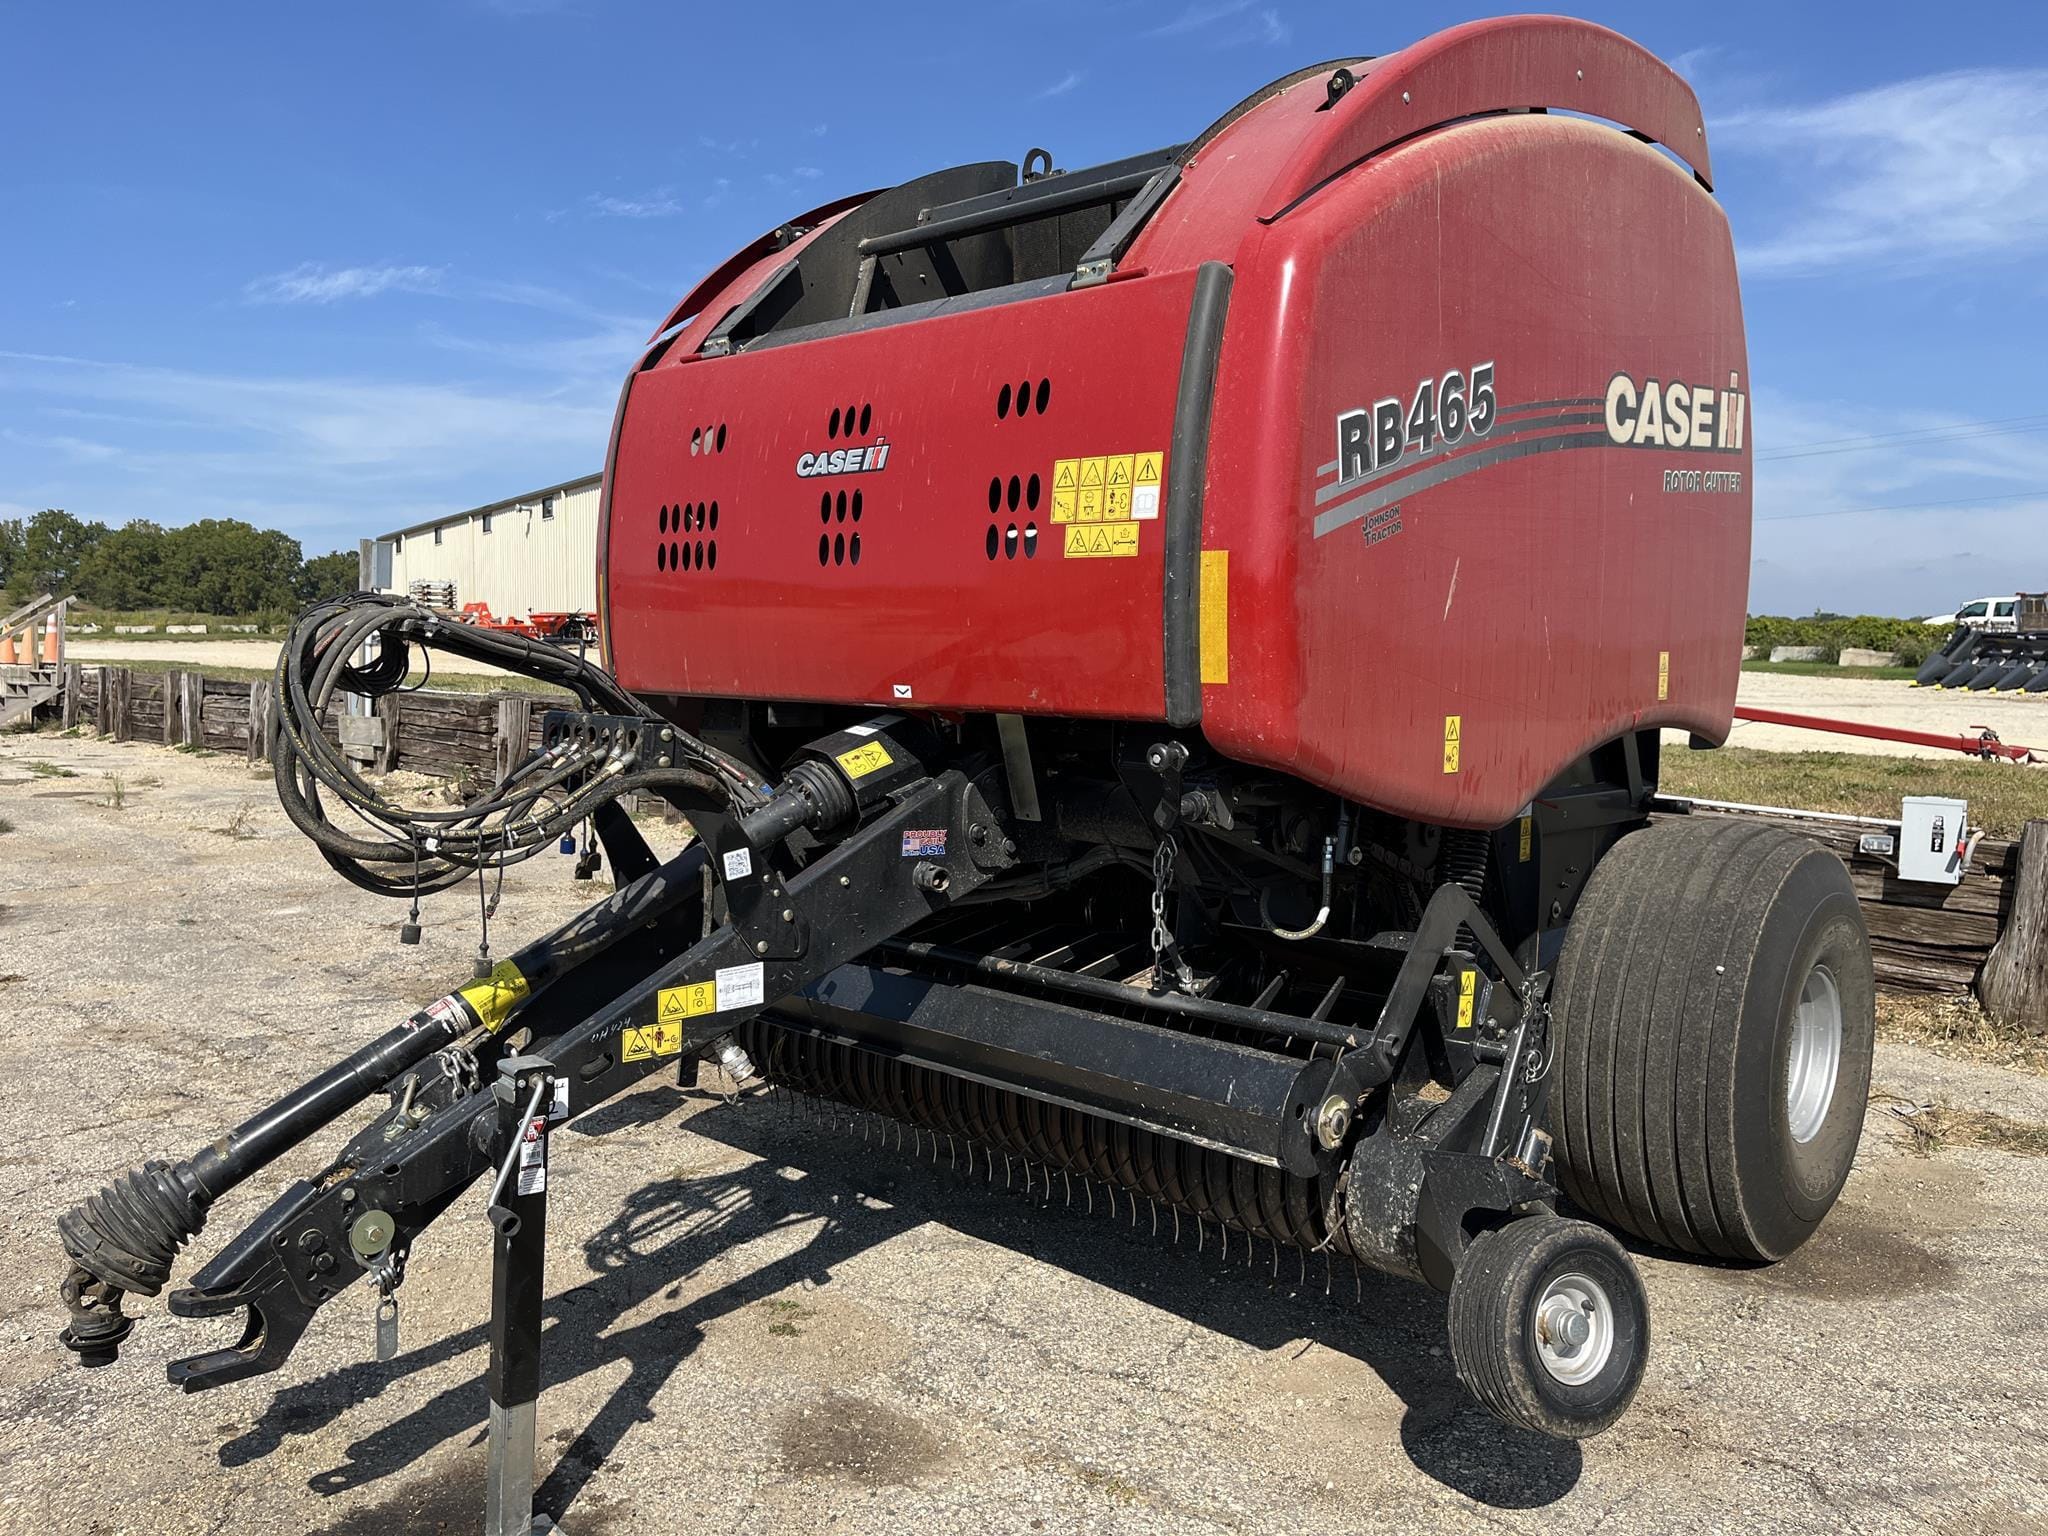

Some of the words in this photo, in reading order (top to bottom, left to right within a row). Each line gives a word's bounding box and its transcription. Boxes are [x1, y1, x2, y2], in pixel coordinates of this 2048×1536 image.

[1337, 360, 1497, 486] RB465
[1604, 373, 1715, 448] CASE
[1663, 470, 1701, 493] ROTOR
[1703, 471, 1742, 493] CUTTER
[1364, 520, 1402, 547] TRACTOR
[920, 845, 945, 856] USA
